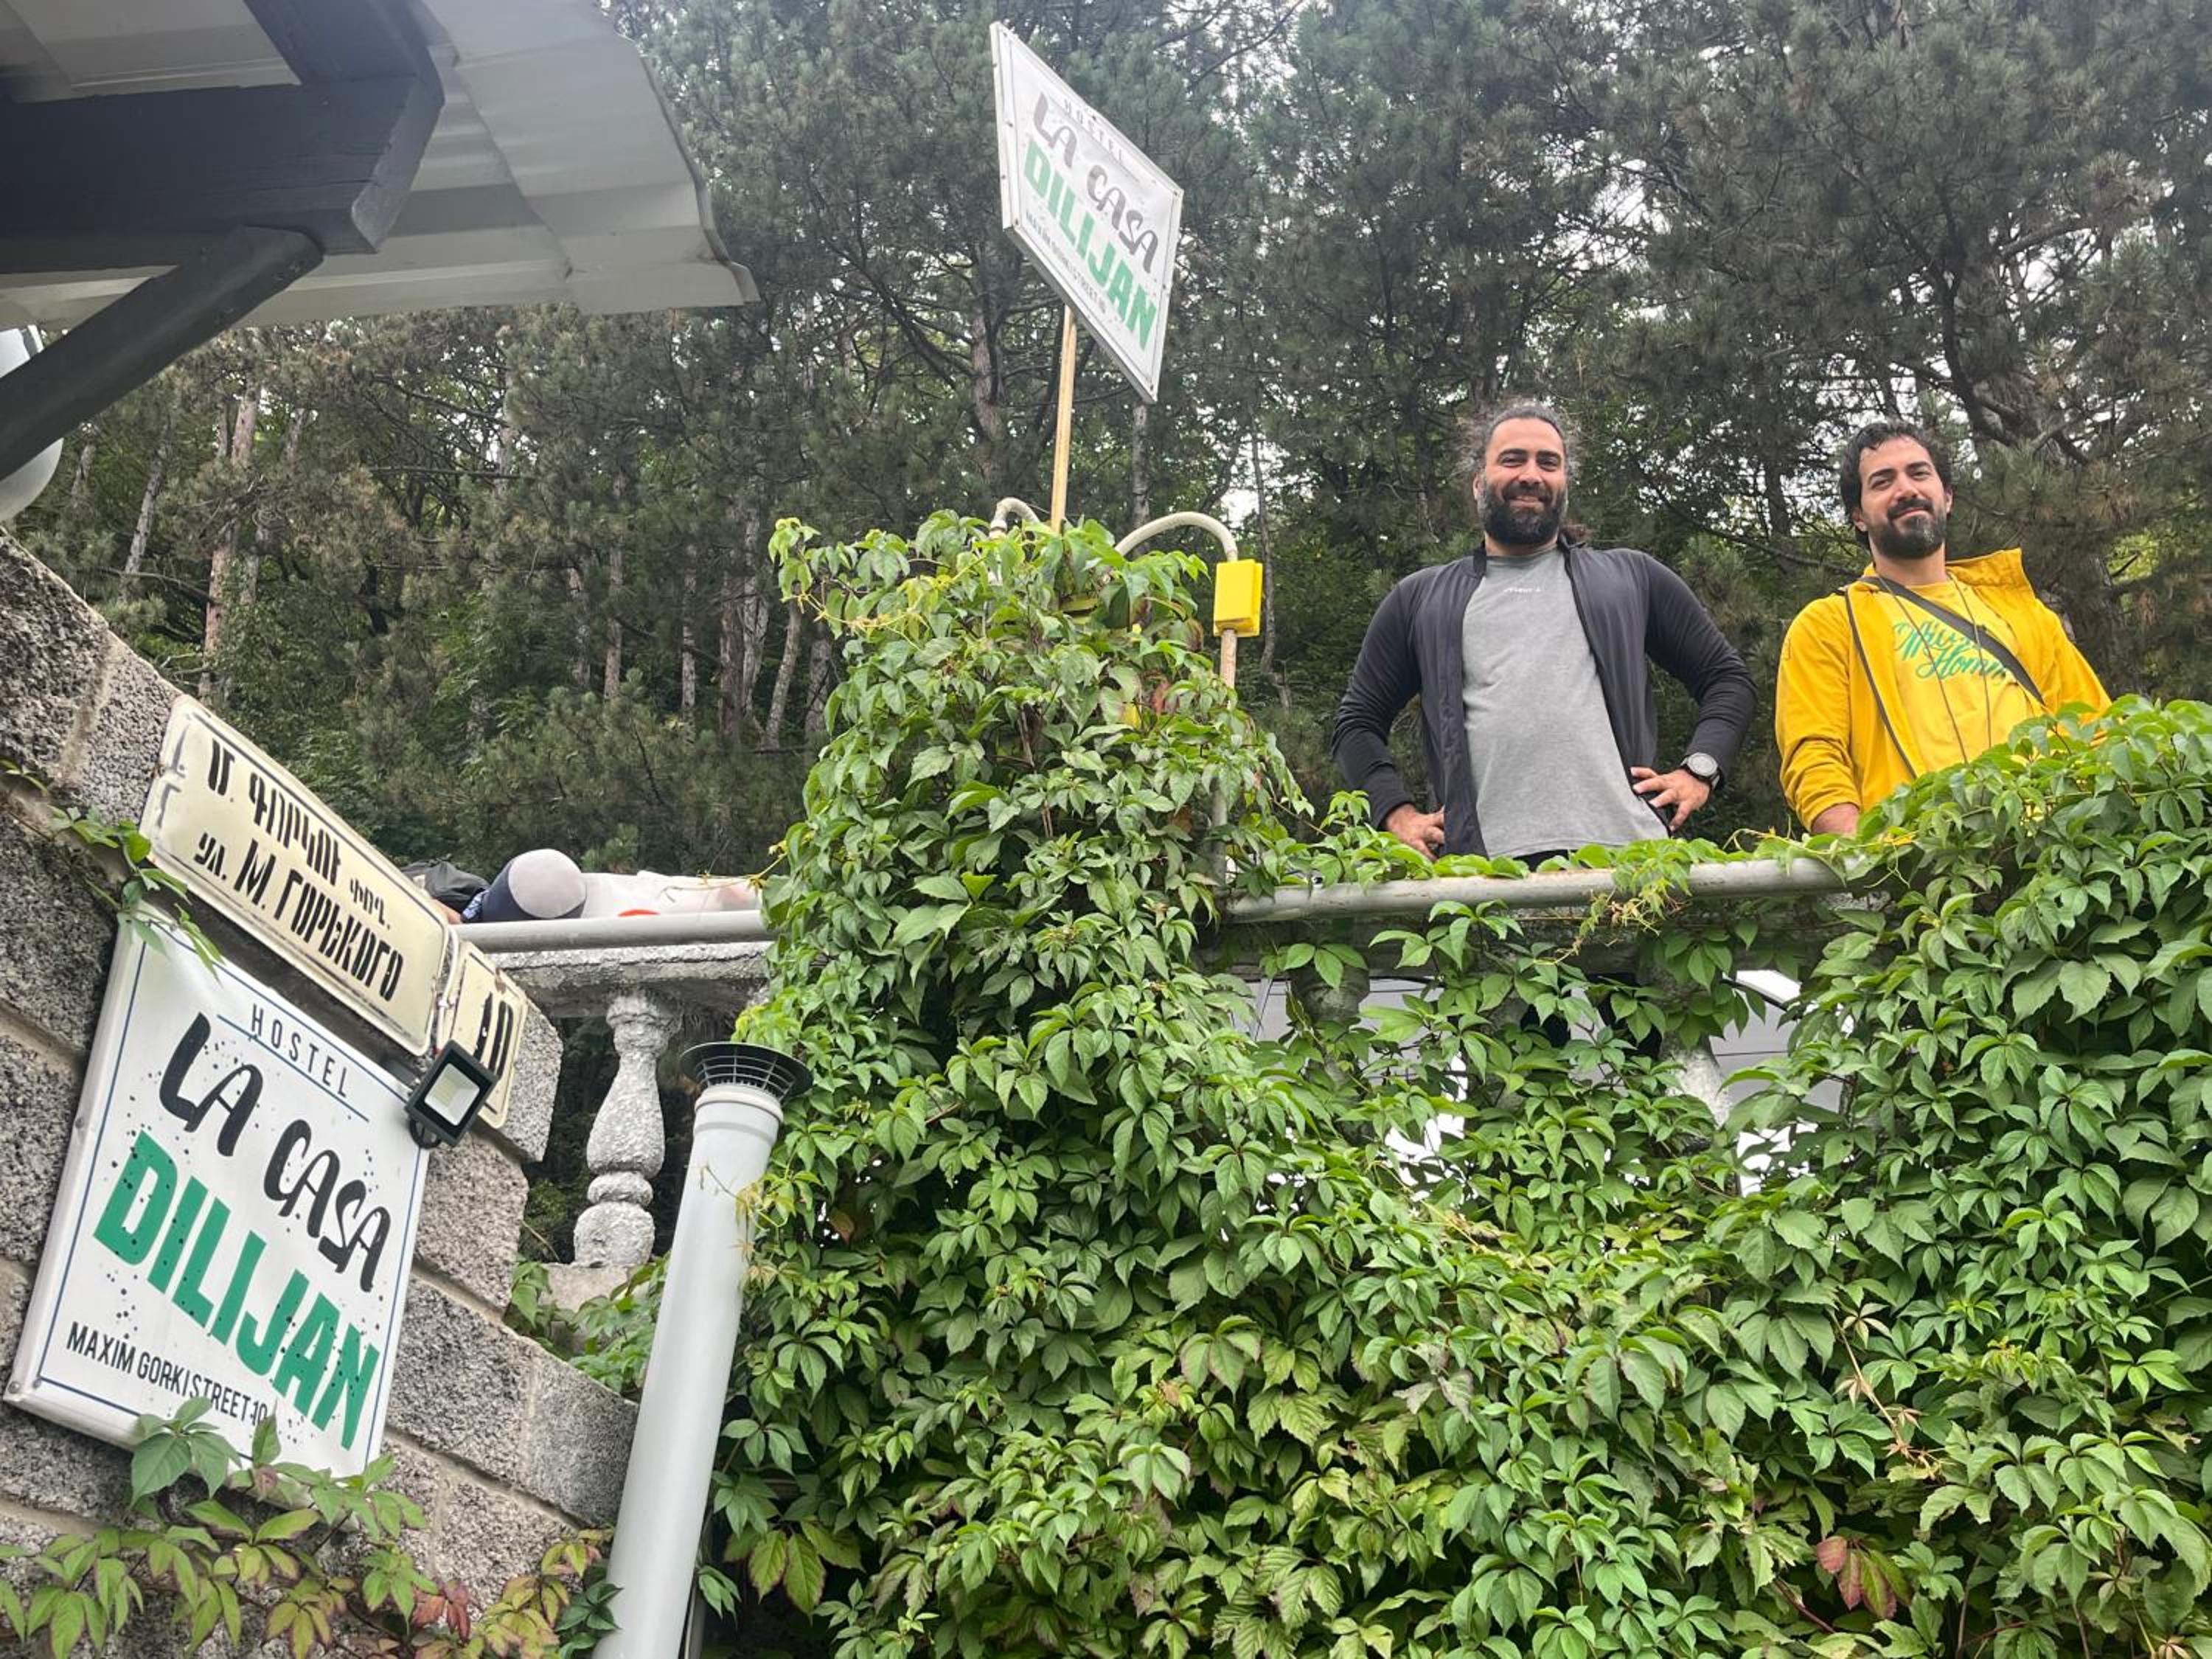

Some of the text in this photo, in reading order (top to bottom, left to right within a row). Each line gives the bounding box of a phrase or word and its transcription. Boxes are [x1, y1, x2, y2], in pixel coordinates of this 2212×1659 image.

[1023, 139, 1158, 351] DILIJAN
[1034, 91, 1158, 274] LA CASA
[274, 869, 404, 1002] ГОРЬКОГО
[250, 1004, 348, 1098] HOSTEL
[159, 1012, 392, 1293] LA CASA
[66, 1321, 136, 1374] MAXIM
[136, 1351, 192, 1397] GORKI
[189, 1374, 252, 1425] STREET
[93, 1129, 380, 1451] DILIJAN
